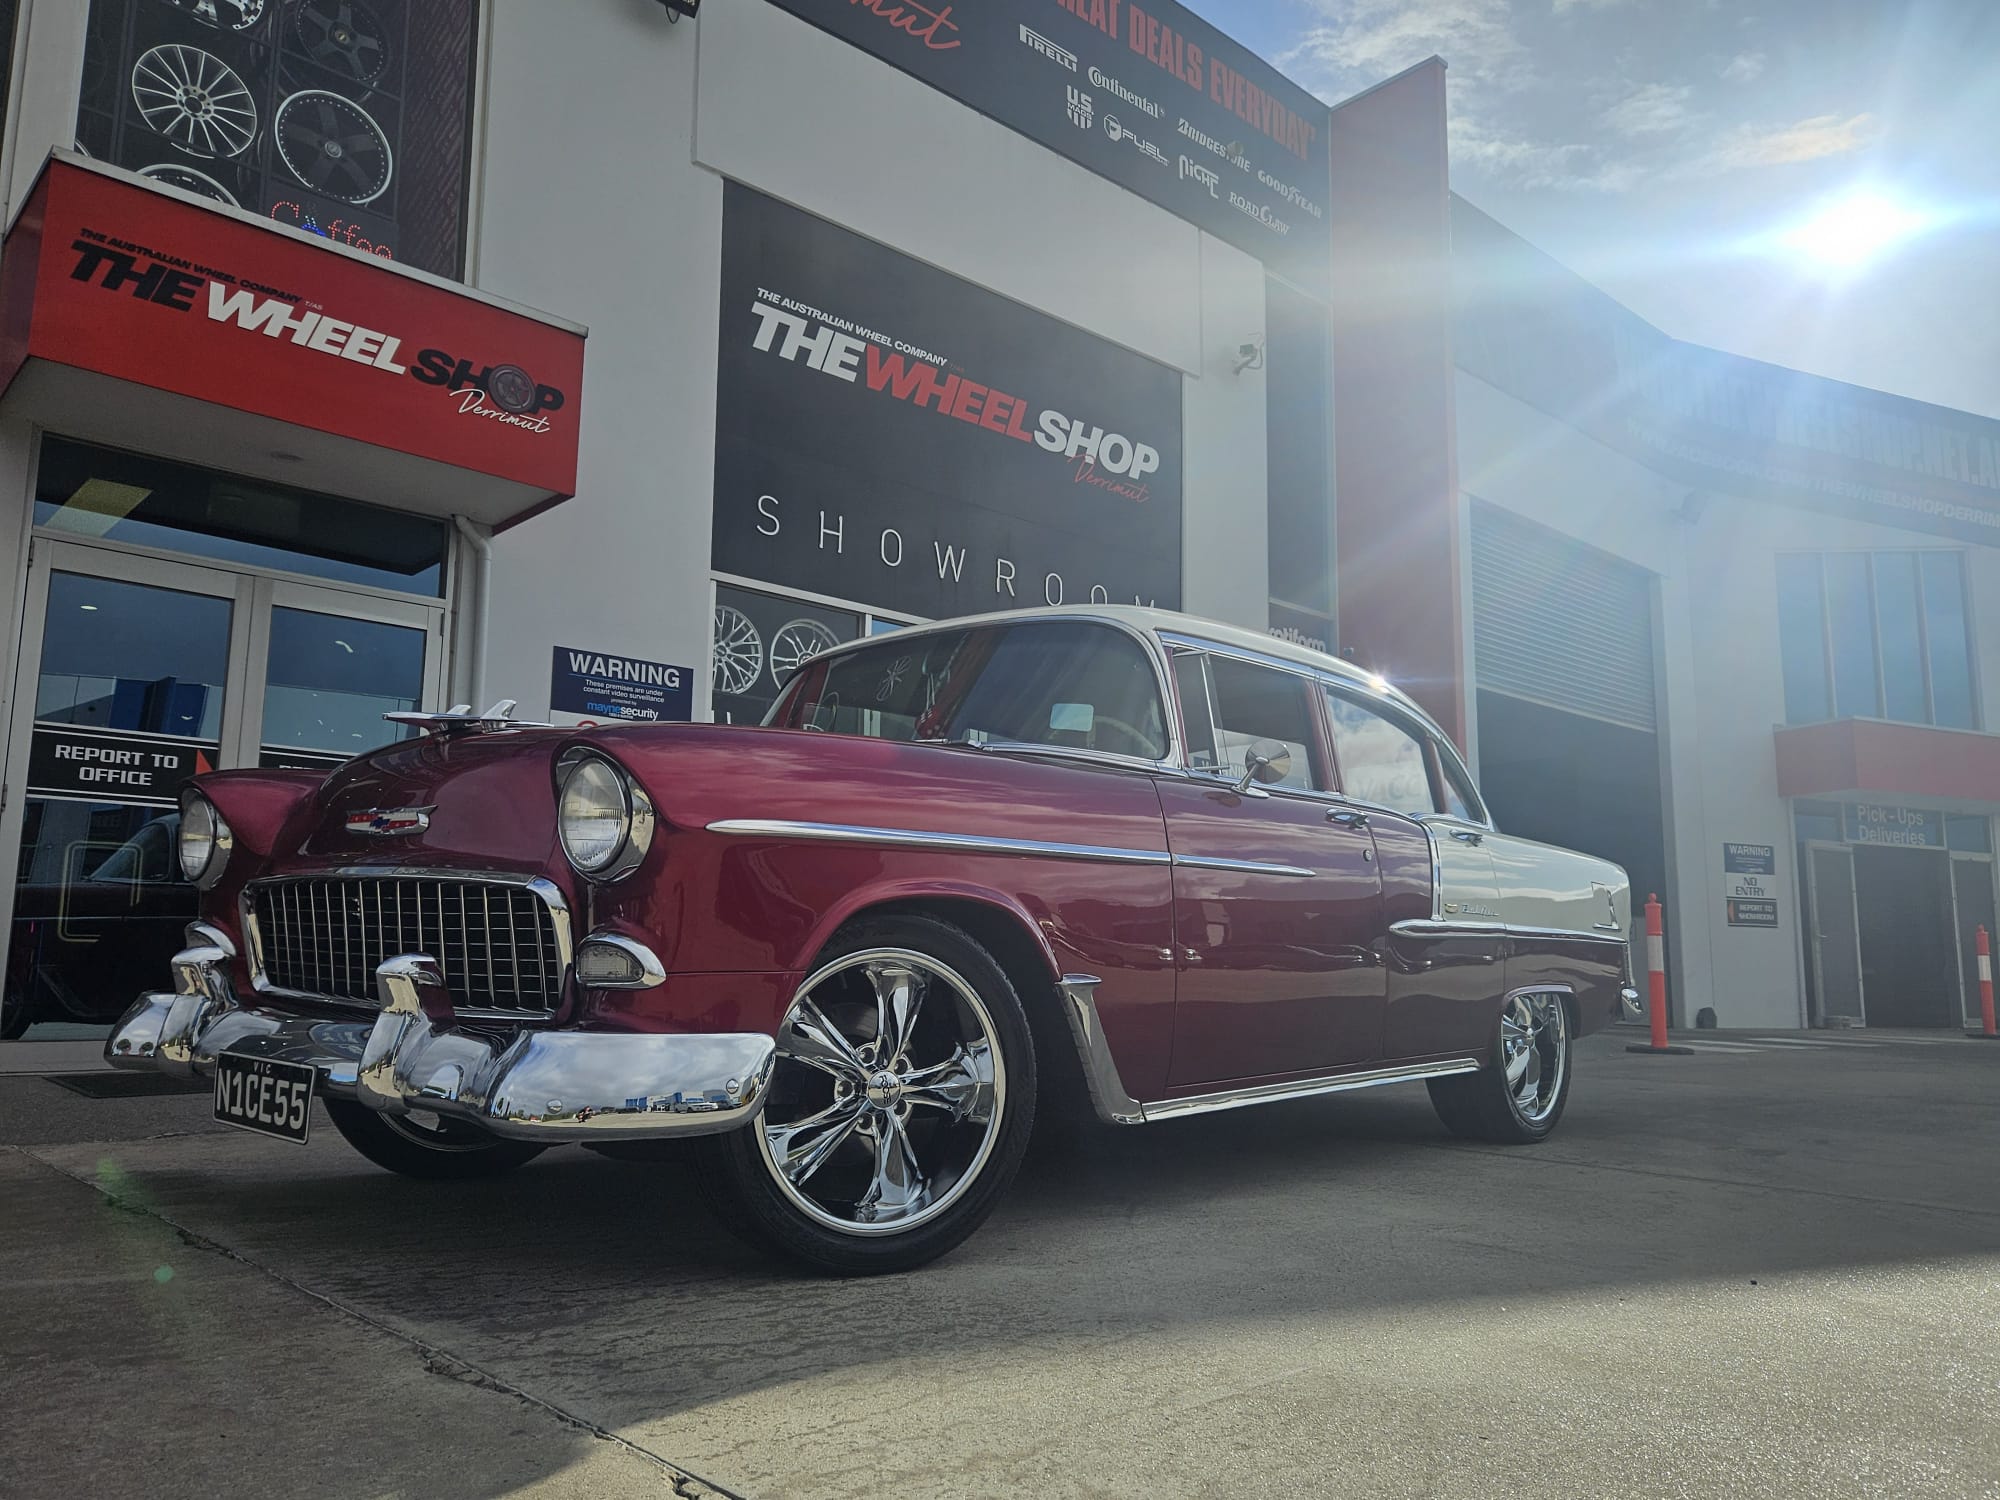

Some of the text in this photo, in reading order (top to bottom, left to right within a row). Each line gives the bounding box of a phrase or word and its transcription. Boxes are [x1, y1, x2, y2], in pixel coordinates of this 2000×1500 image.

[1020, 24, 1077, 72] PIRELLI
[1130, 4, 1203, 92] DEALS
[1088, 66, 1159, 119] Continental
[1122, 129, 1168, 161] FUEL
[1178, 118, 1251, 172] BRIDGESONE
[1258, 169, 1322, 219] GOODYEAR
[81, 228, 107, 243] THE
[108, 238, 192, 269] AUSTRALIAN
[194, 264, 236, 284] WHEEL
[240, 280, 302, 303] COMPANY
[71, 239, 564, 415] THE WHEEL SHOP
[757, 287, 948, 367] THE AUSTRALIAN WHEEL COMPANY
[449, 388, 550, 433] Derrimut
[752, 301, 1160, 480] THE WHEEL SHOP
[1067, 453, 1150, 502] Derrimut
[569, 652, 680, 688] WARNING
[605, 683, 633, 692] premises
[645, 688, 663, 696] under
[583, 686, 665, 703] constant video surveillance
[55, 744, 178, 769] REPORT TO
[79, 766, 152, 786] OFFICE
[1729, 844, 1770, 857] WARNING
[1859, 825, 1926, 845] Deliveries
[1735, 886, 1766, 897] ENTRY
[1743, 877, 1757, 886] NO
[253, 1061, 271, 1074] VIC
[216, 1067, 307, 1130] N1CE55
